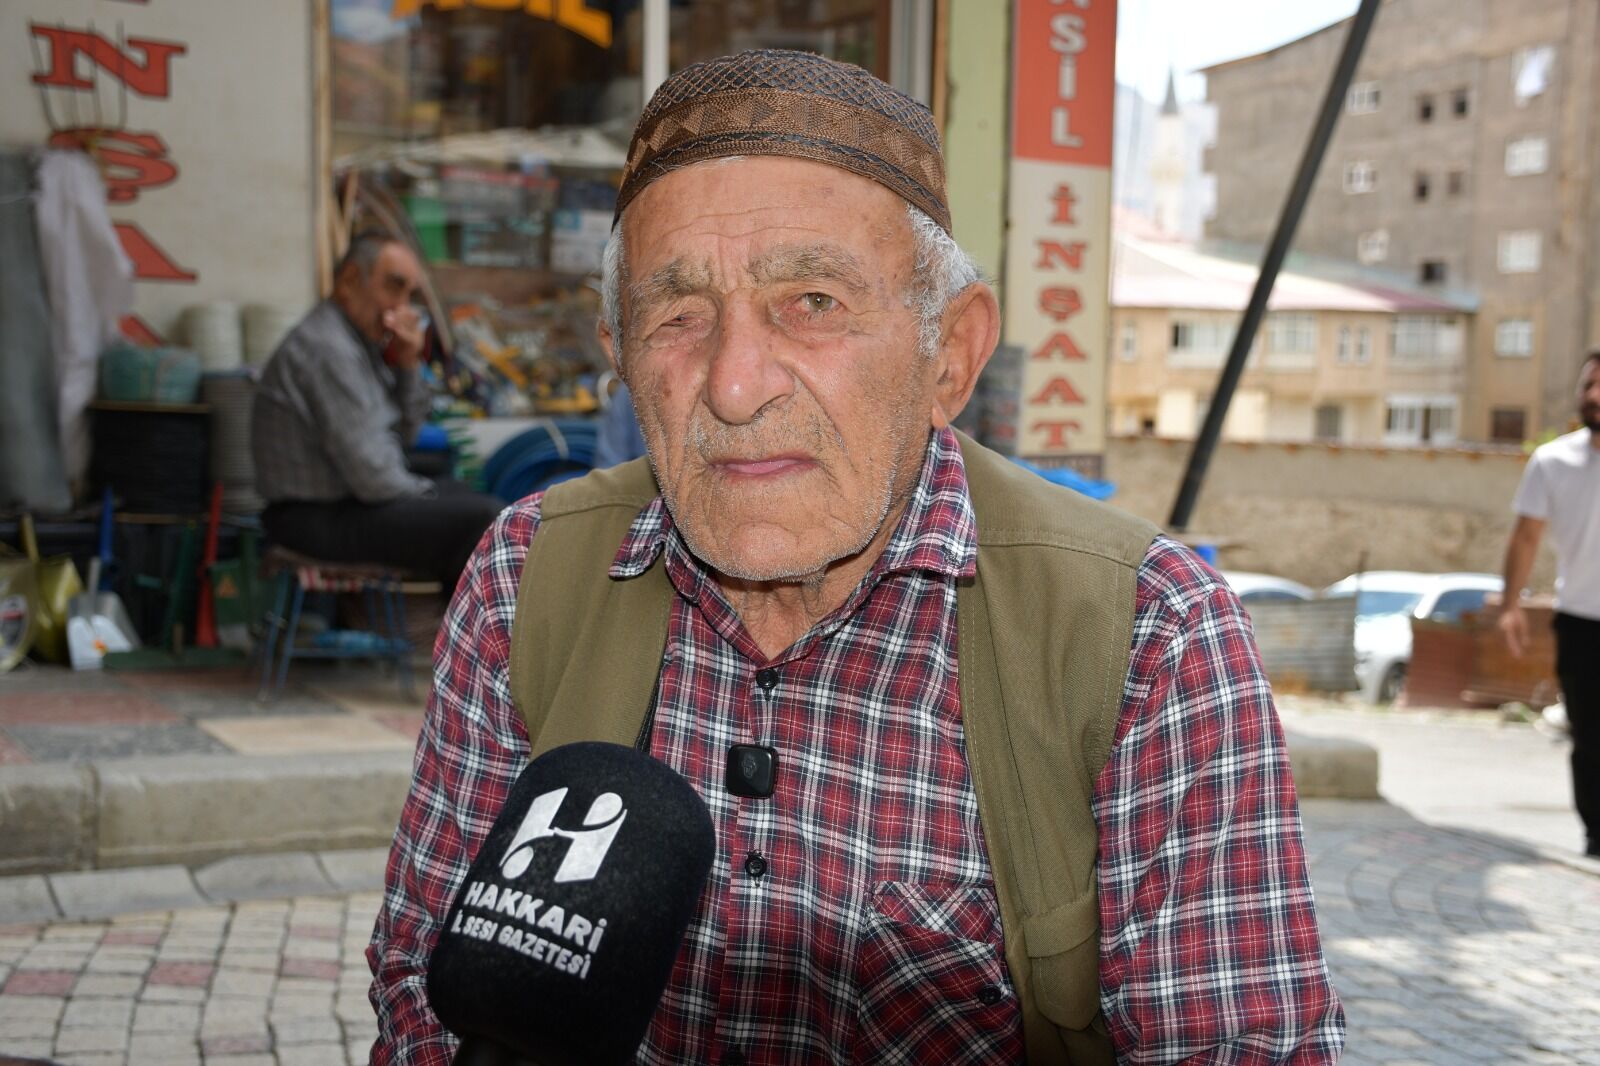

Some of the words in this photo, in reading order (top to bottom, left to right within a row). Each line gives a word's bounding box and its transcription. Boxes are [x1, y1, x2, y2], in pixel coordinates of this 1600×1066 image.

[1047, 0, 1091, 148] SİL
[1029, 183, 1089, 449] İNŞAAT
[497, 924, 592, 980] GAZETESİ
